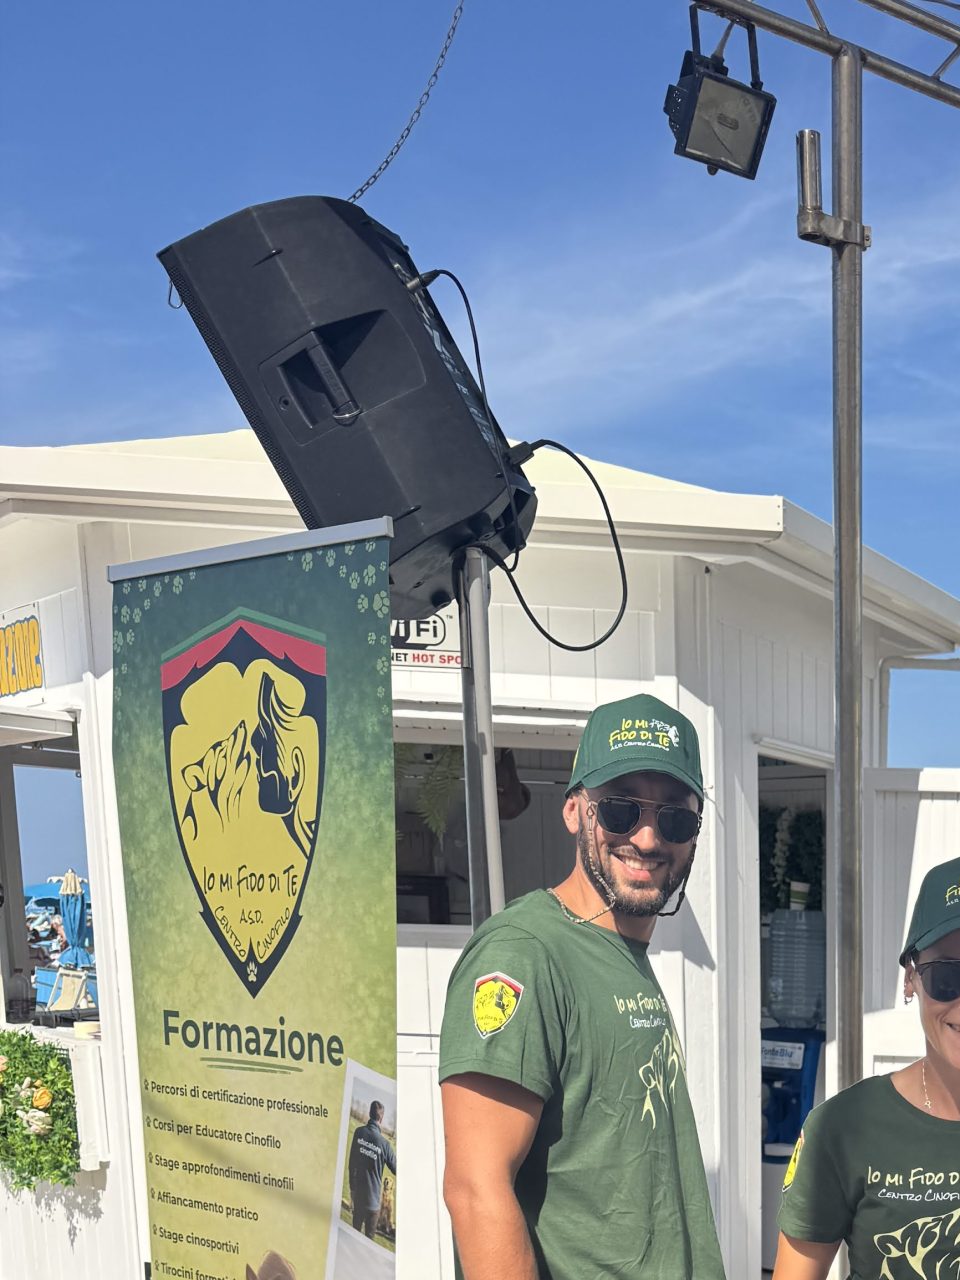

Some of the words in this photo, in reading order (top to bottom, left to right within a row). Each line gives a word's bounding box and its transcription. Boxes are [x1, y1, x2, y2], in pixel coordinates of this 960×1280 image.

[412, 653, 435, 664] HOT
[621, 717, 632, 731] IO
[635, 719, 648, 729] MI
[608, 730, 637, 747] FIDO
[639, 731, 652, 740] DI
[655, 732, 670, 747] TE
[203, 866, 215, 895] IO
[220, 873, 233, 893] MI
[237, 864, 265, 898] FIDO
[268, 873, 281, 893] DI
[283, 864, 298, 897] TE
[613, 994, 625, 1014] IO
[163, 1009, 345, 1067] Formazione
[151, 1081, 188, 1098] Percorsi
[190, 1086, 200, 1098] di
[202, 1089, 264, 1107] certificazione
[267, 1099, 329, 1118] professionale
[153, 1117, 175, 1131] Corsi
[177, 1123, 193, 1136] per
[196, 1124, 243, 1142] Educatore
[245, 1132, 281, 1149] Cinofilo
[155, 1155, 180, 1171] Stage
[182, 1160, 261, 1184] approfondimenti
[263, 1173, 294, 1191] cinofili
[867, 1165, 881, 1184] IO
[885, 1174, 902, 1186] MI
[909, 1167, 945, 1189] FIDO
[157, 1191, 224, 1214] Affiancamento
[226, 1206, 259, 1221] pratico
[877, 1189, 922, 1201] CENTRO
[159, 1226, 184, 1243] Stage
[186, 1232, 239, 1254] cinosportivi
[161, 1262, 194, 1280] Tirocini
